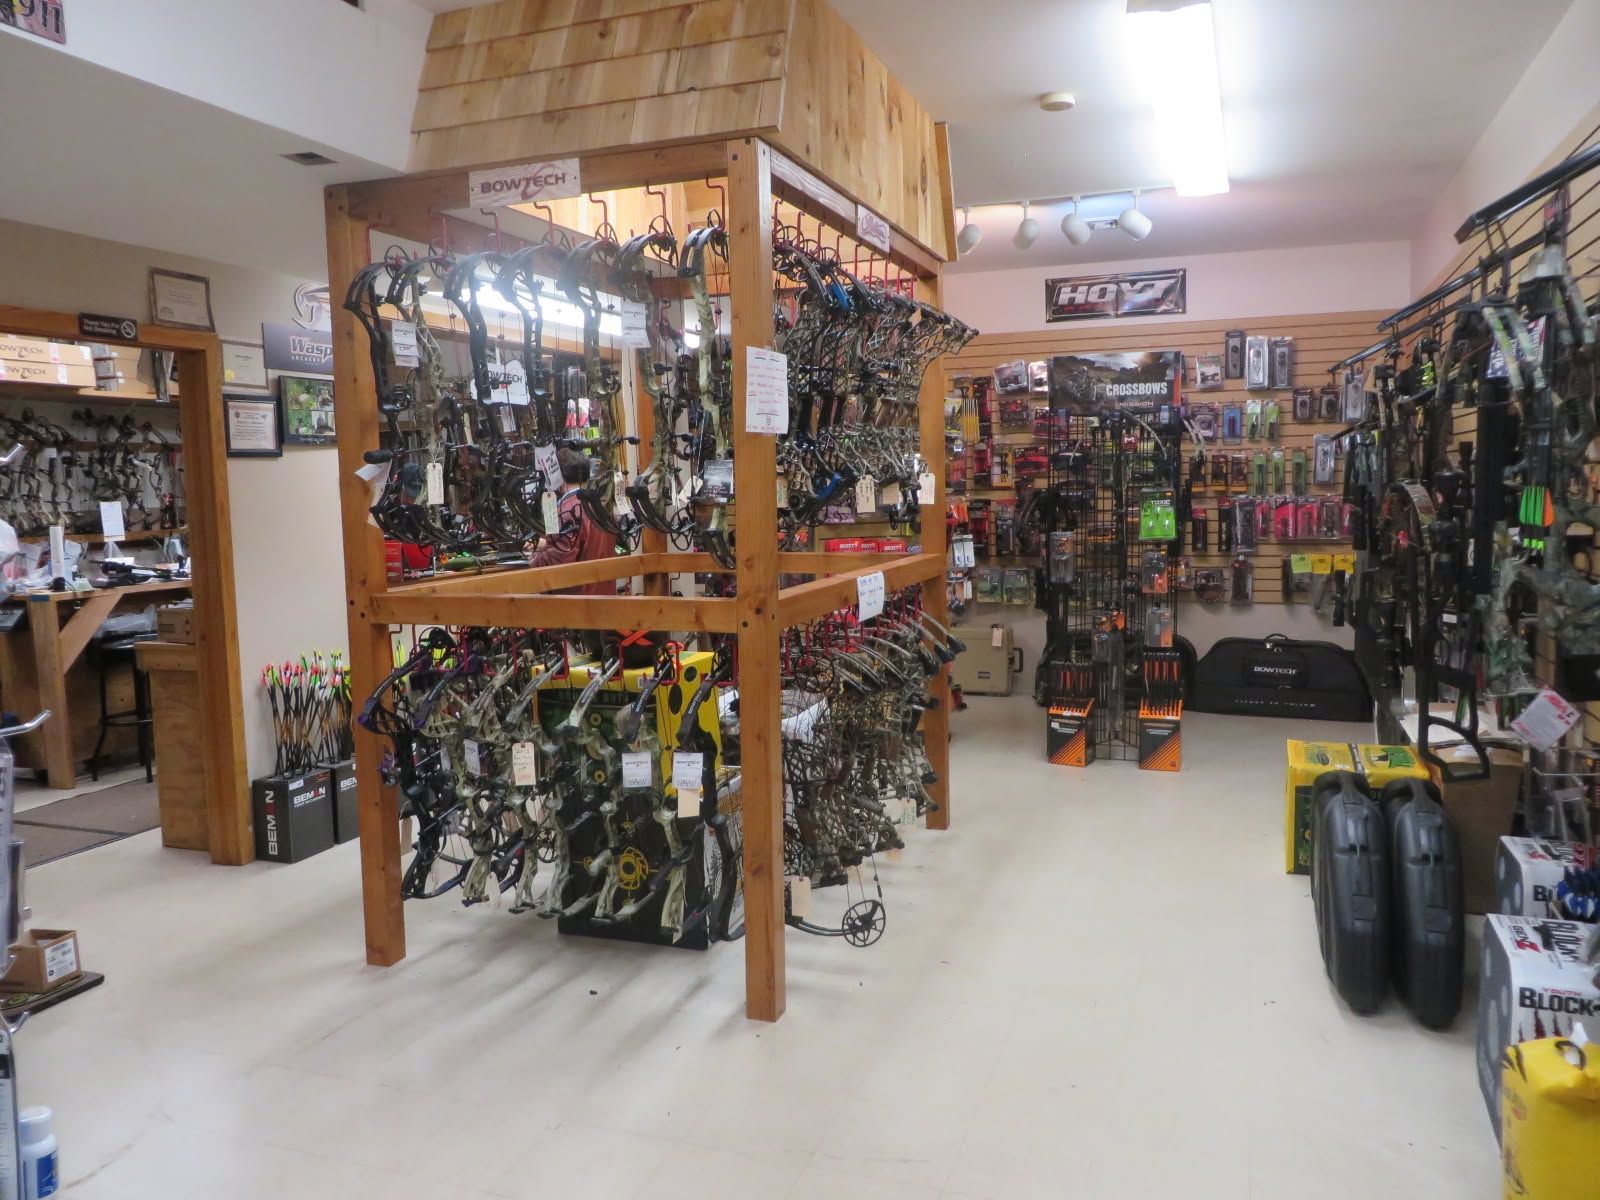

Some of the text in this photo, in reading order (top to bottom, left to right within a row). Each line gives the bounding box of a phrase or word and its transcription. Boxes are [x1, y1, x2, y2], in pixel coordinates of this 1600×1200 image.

[480, 170, 567, 200] BOWTECH
[1058, 280, 1178, 305] HOYT
[0, 344, 43, 357] OWTECH
[289, 336, 333, 362] Wasp
[1106, 382, 1168, 396] CROSSBOWS
[1253, 665, 1297, 675] BOWTECH
[1519, 987, 1594, 1016] BLOCK
